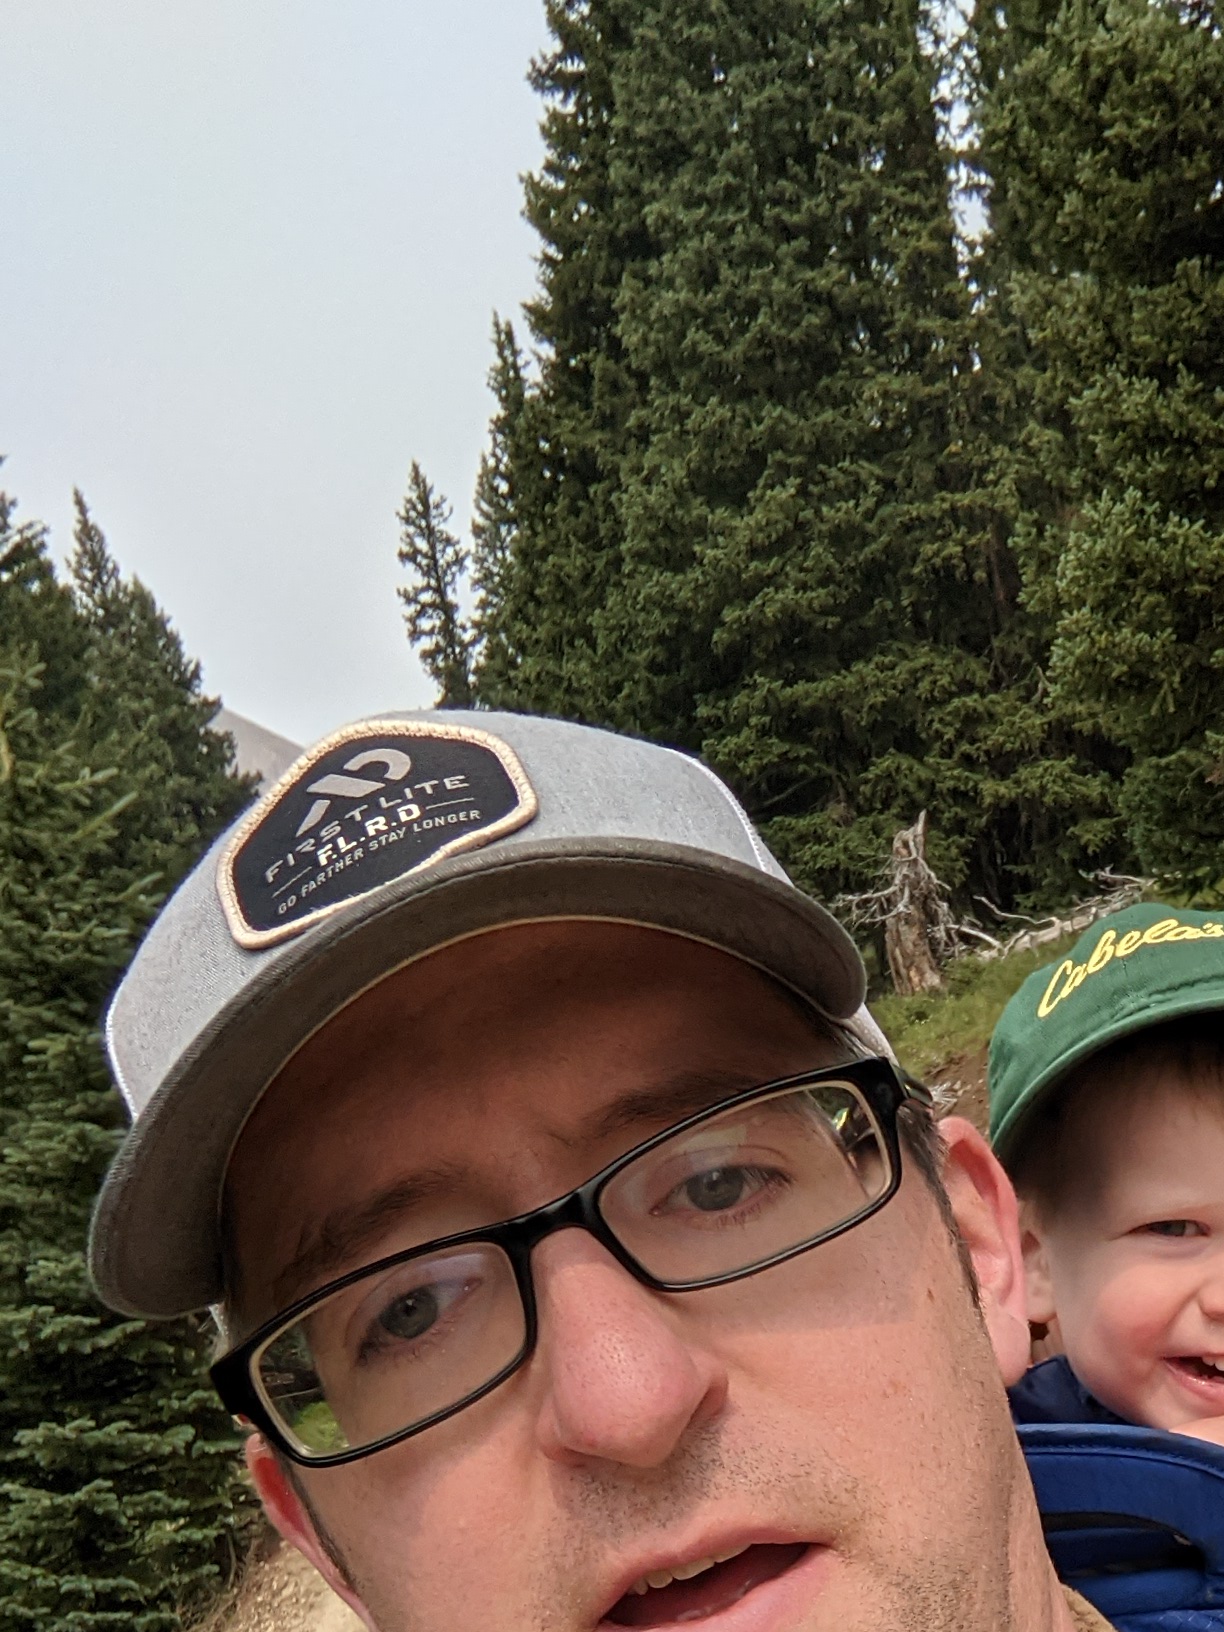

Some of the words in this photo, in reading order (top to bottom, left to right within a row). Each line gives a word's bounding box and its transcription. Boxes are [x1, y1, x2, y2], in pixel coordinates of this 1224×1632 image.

[265, 805, 369, 883] FIRST
[379, 775, 470, 809] LITE
[278, 895, 297, 914] GO
[301, 847, 364, 898] FARTHER
[369, 827, 406, 851] STAY
[413, 809, 480, 833] LONGER
